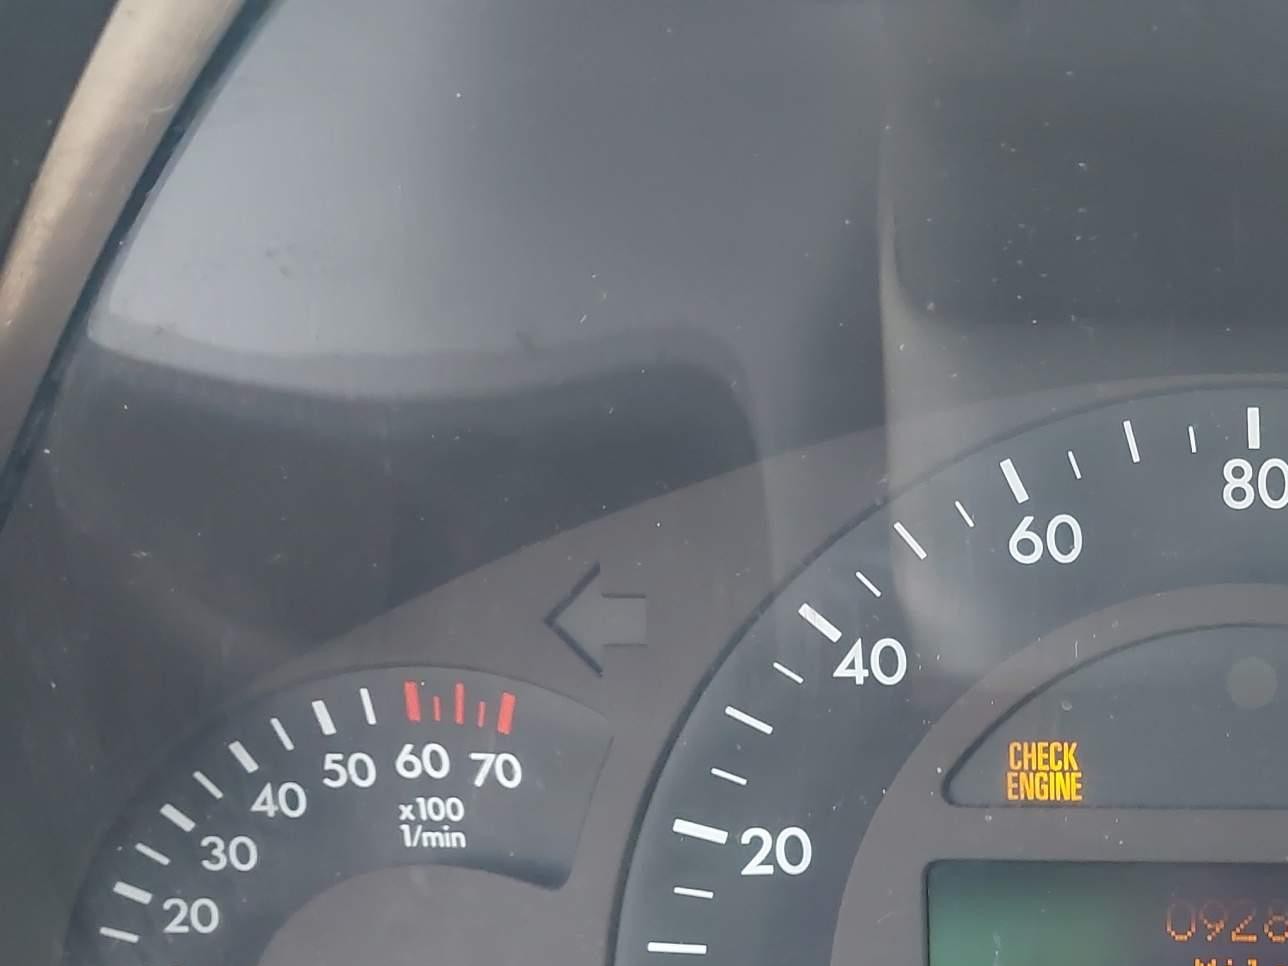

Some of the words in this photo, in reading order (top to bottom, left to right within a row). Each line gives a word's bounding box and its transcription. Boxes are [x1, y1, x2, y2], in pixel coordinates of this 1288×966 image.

[1008, 514, 1083, 564] 60
[833, 638, 907, 685] 40
[323, 753, 376, 788] 50
[396, 744, 450, 779] 60
[468, 752, 522, 788] 70
[1008, 742, 1079, 771] CHECK
[250, 782, 307, 818] 40
[1007, 772, 1083, 801] ENGINE
[400, 797, 464, 822] x100
[201, 836, 257, 872] 30
[401, 824, 466, 849] 1/min
[740, 827, 812, 875] 20
[163, 898, 219, 934] 20
